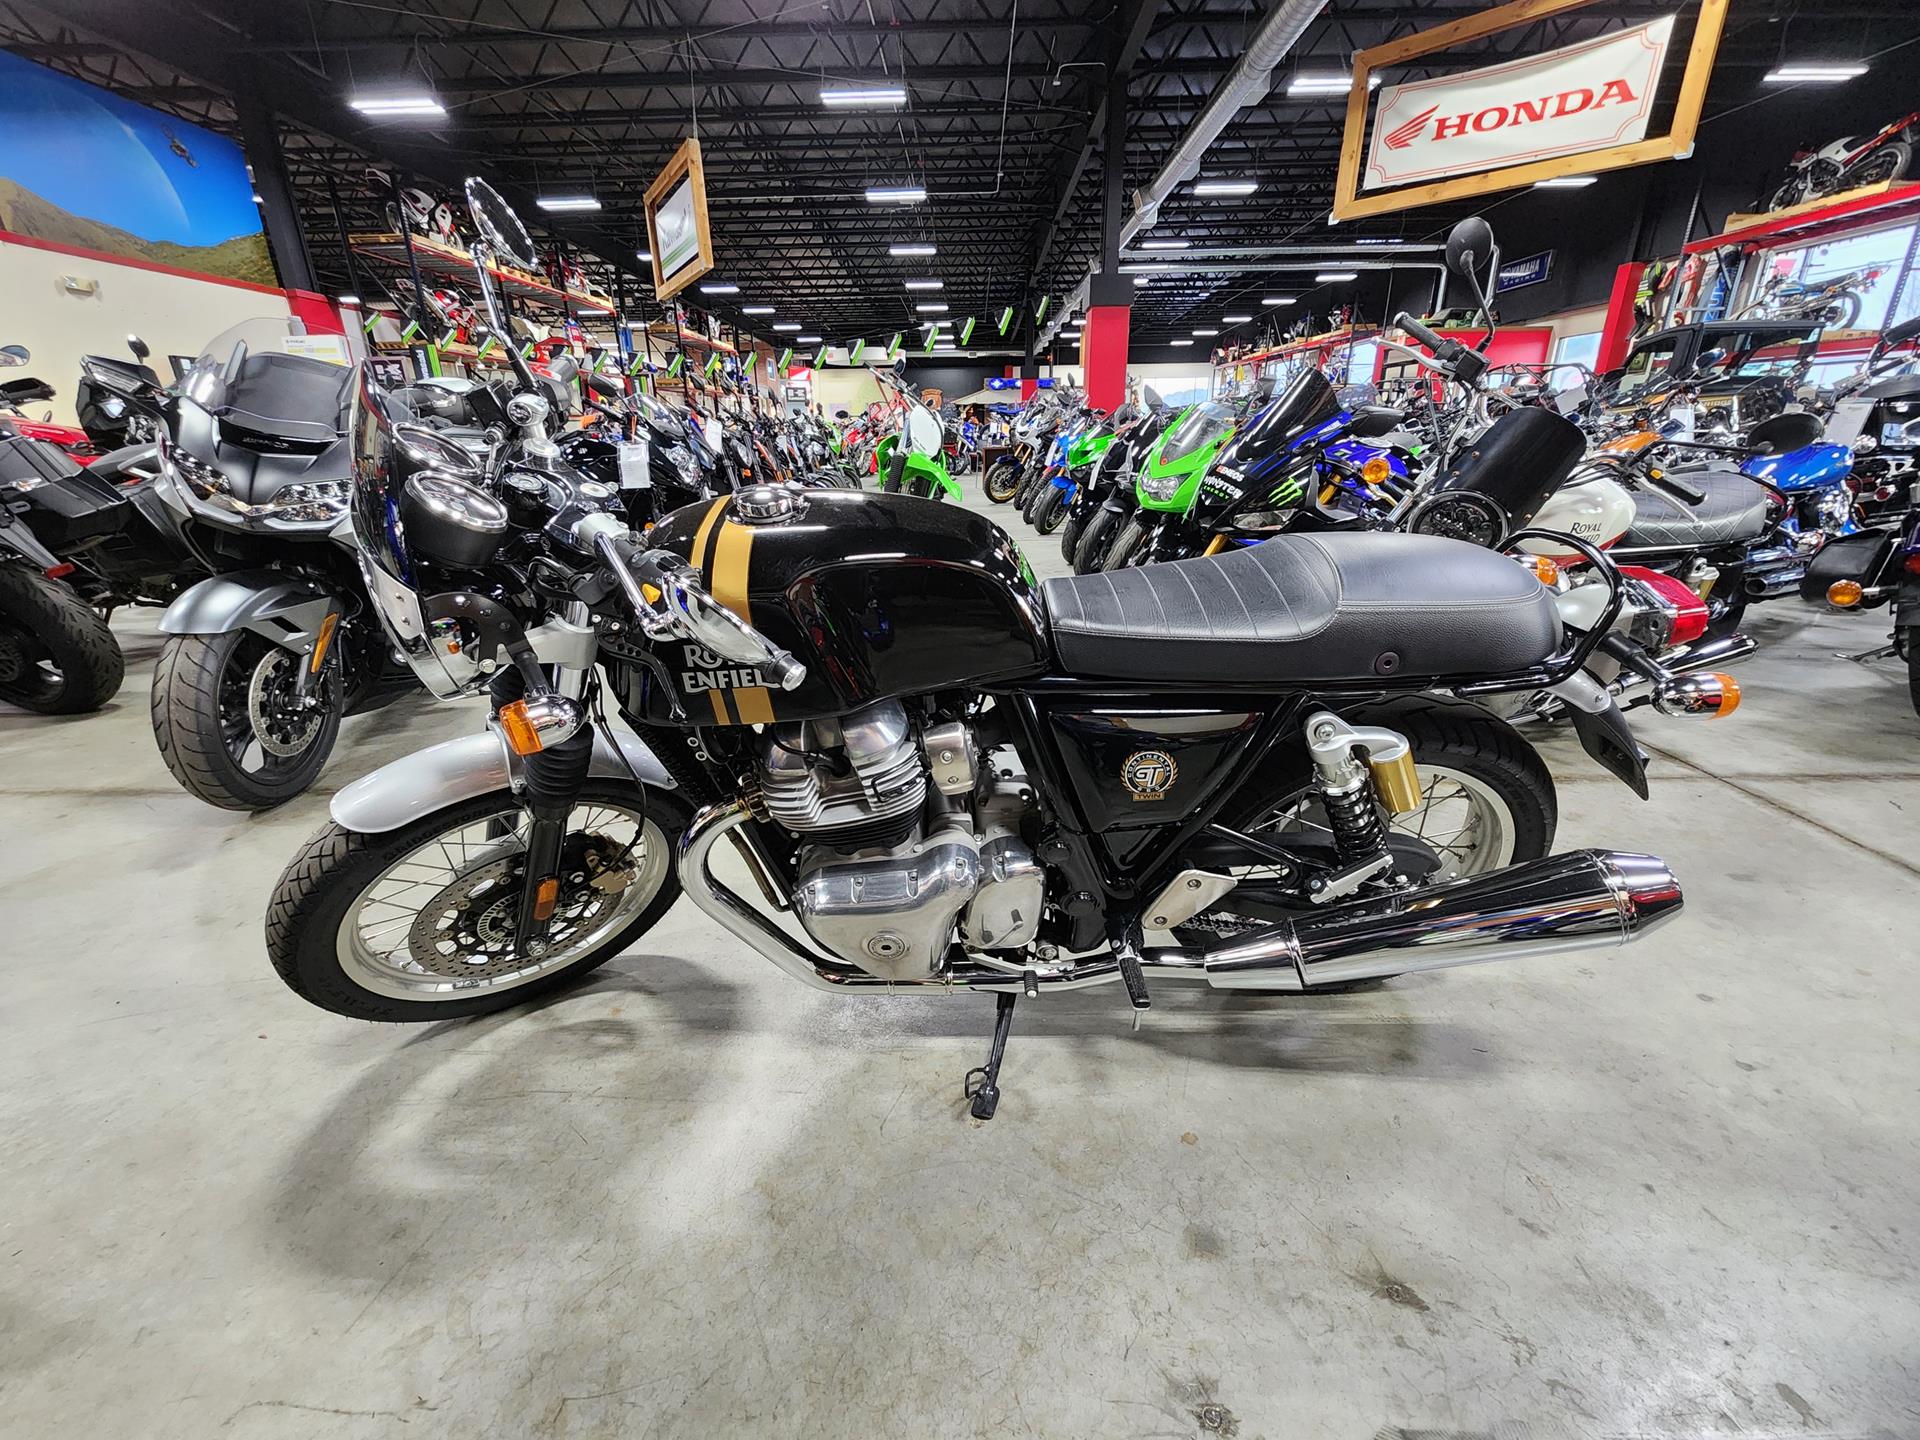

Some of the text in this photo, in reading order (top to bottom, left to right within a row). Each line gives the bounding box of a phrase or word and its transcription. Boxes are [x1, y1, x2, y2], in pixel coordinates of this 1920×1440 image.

[1431, 79, 1639, 141] HONDA
[1570, 522, 1602, 535] ROYAL
[681, 669, 781, 693] ENFIEL
[1127, 753, 1171, 778] CONTINENTAL
[1134, 765, 1164, 787] GT
